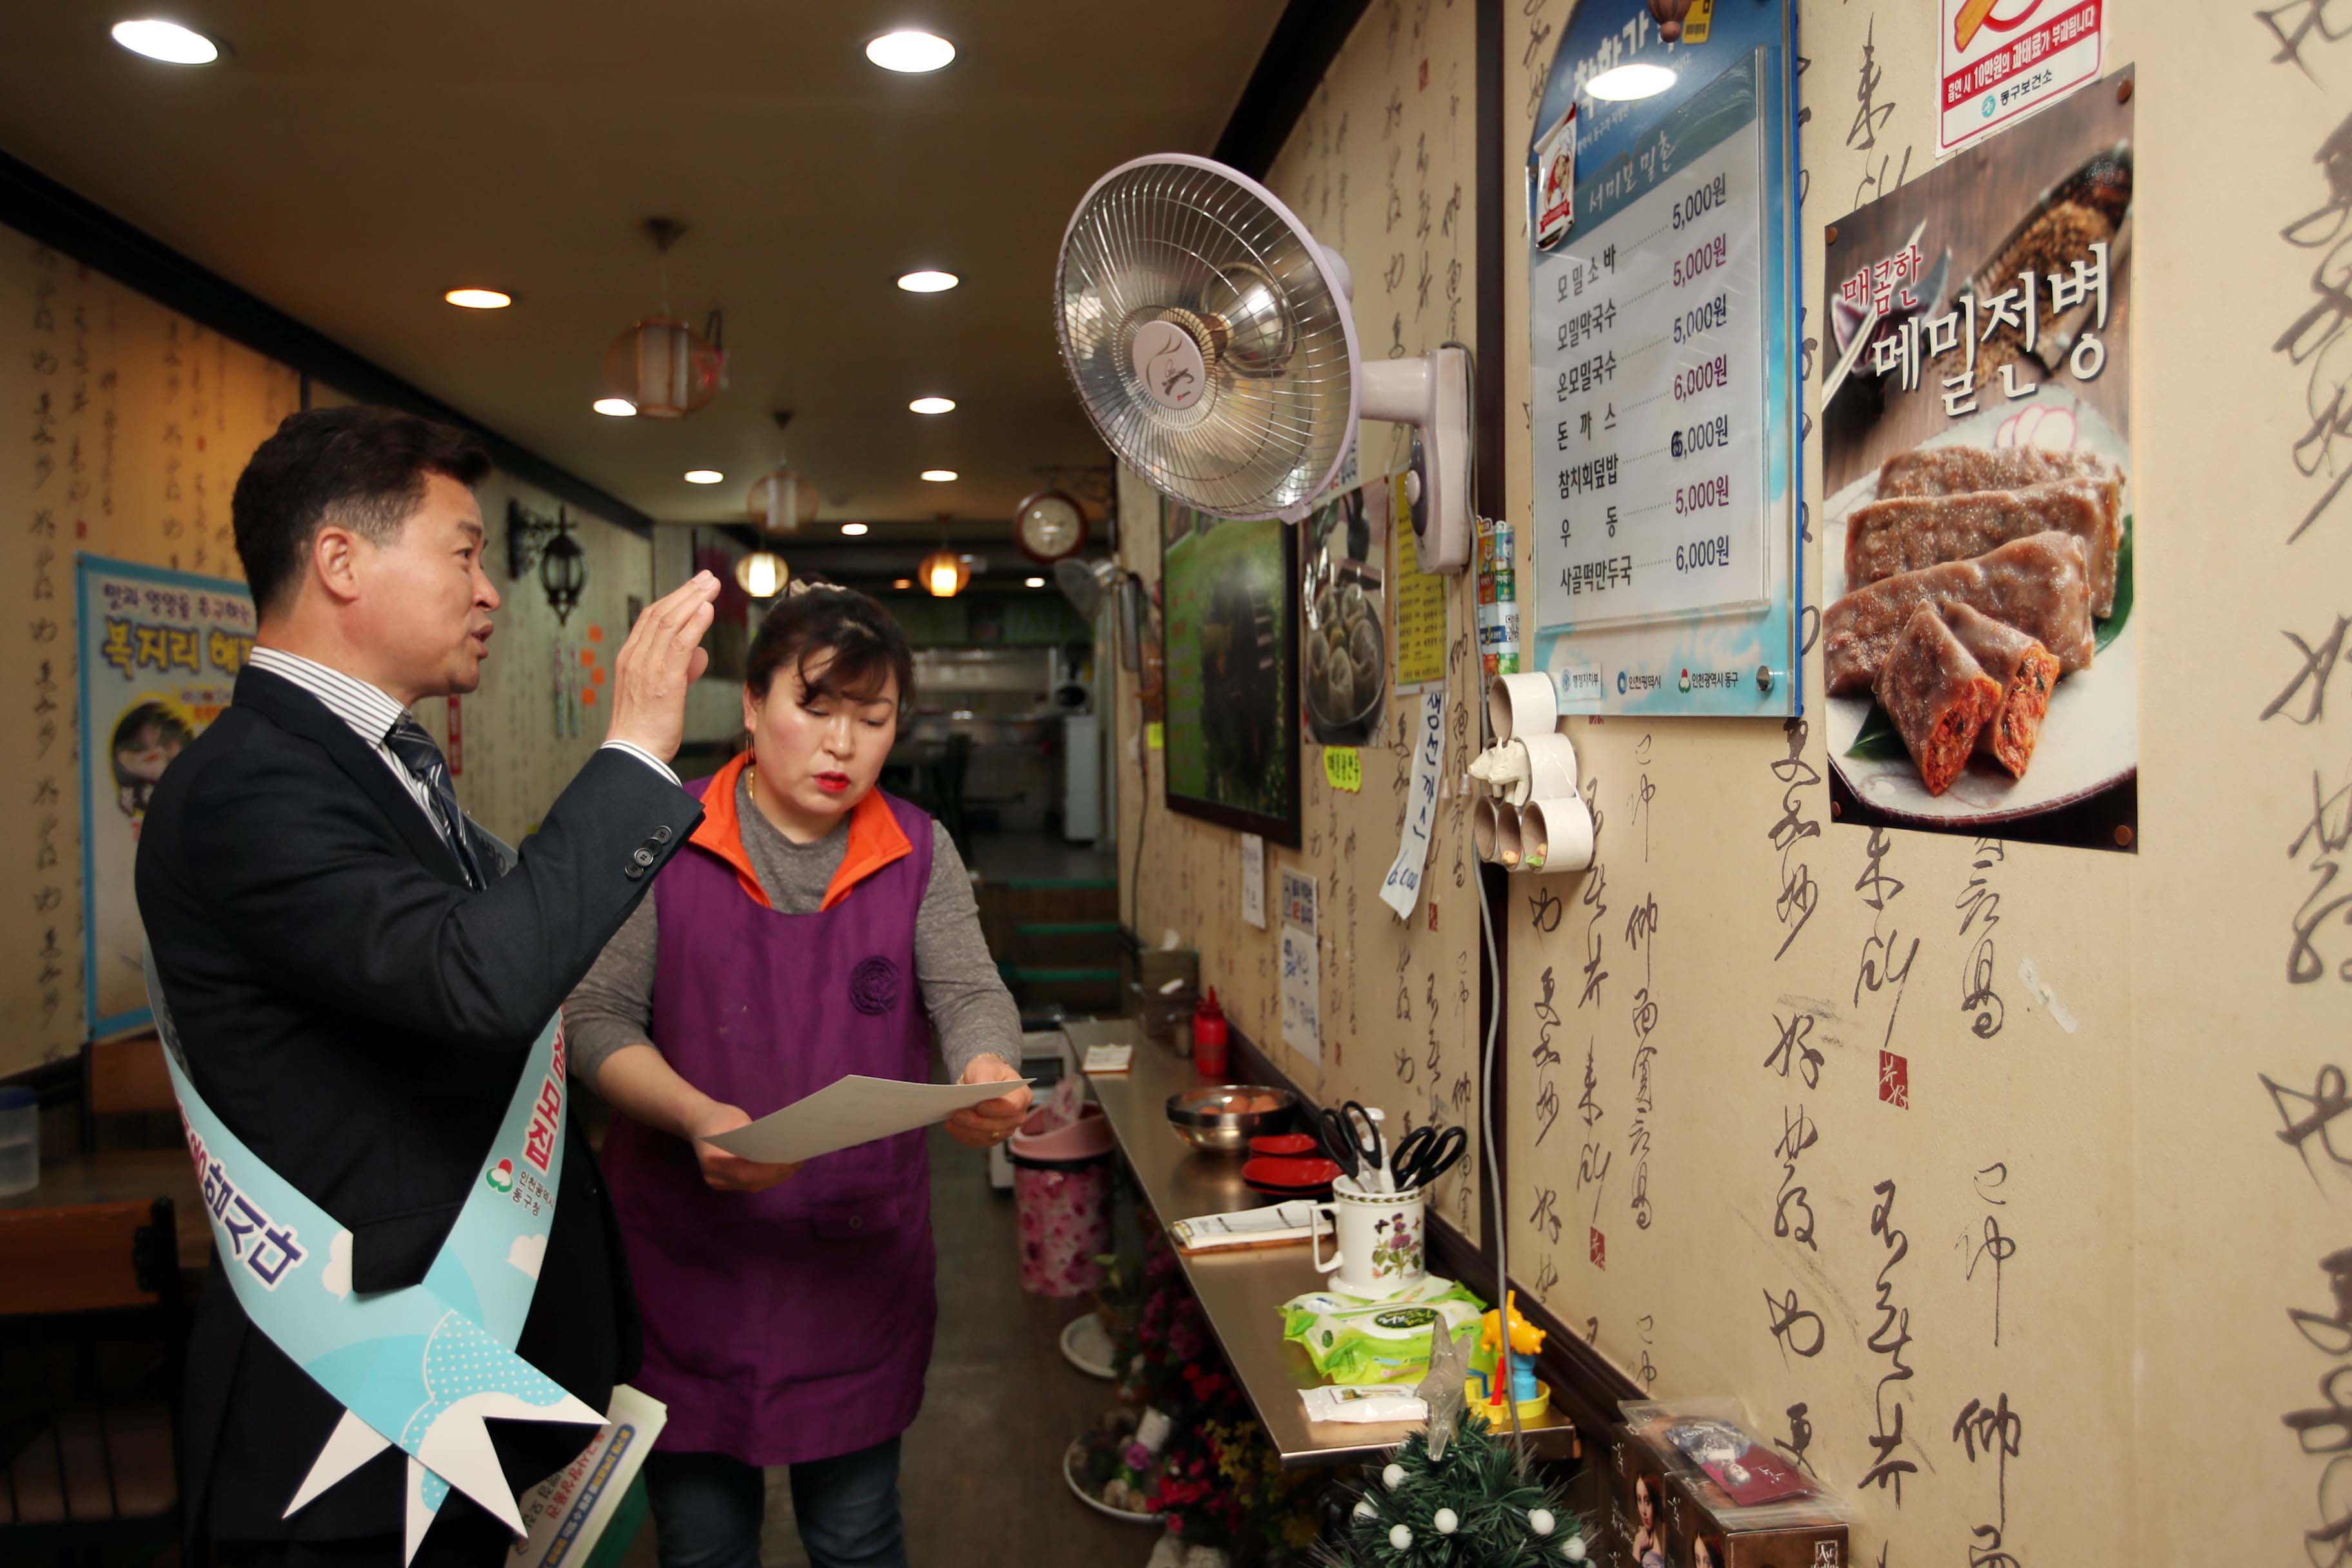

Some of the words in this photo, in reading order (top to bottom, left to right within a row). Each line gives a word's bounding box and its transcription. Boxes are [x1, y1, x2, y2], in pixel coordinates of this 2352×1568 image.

[1974, 52, 2010, 89] 10만원의
[2012, 31, 2050, 70] 과태료가
[2052, 5, 2095, 47] 부과됩니다
[2001, 69, 2052, 106] 동구보건소
[1673, 173, 1726, 231] 5,000원
[1558, 299, 1616, 351] 모밀막국수
[1673, 233, 1726, 288] 5,000원
[1843, 245, 1923, 317] 매콤한
[1557, 351, 1616, 402] 온모밀국수
[1674, 293, 1727, 345] 5,000원
[1872, 242, 2109, 417] 메밀전병
[1674, 354, 1727, 402] 6,000원
[1558, 453, 1618, 500] 참치회덮밥
[1676, 475, 1729, 517] 5,000원
[1560, 555, 1632, 596] 사골떡만두국
[1676, 535, 1729, 574] 6,000원
[1629, 675, 1661, 690] 인천광역시
[1692, 673, 1723, 689] 인천광역시
[1725, 672, 1739, 688] 동구
[525, 1078, 562, 1172] 모집
[513, 1187, 541, 1217] 동구청
